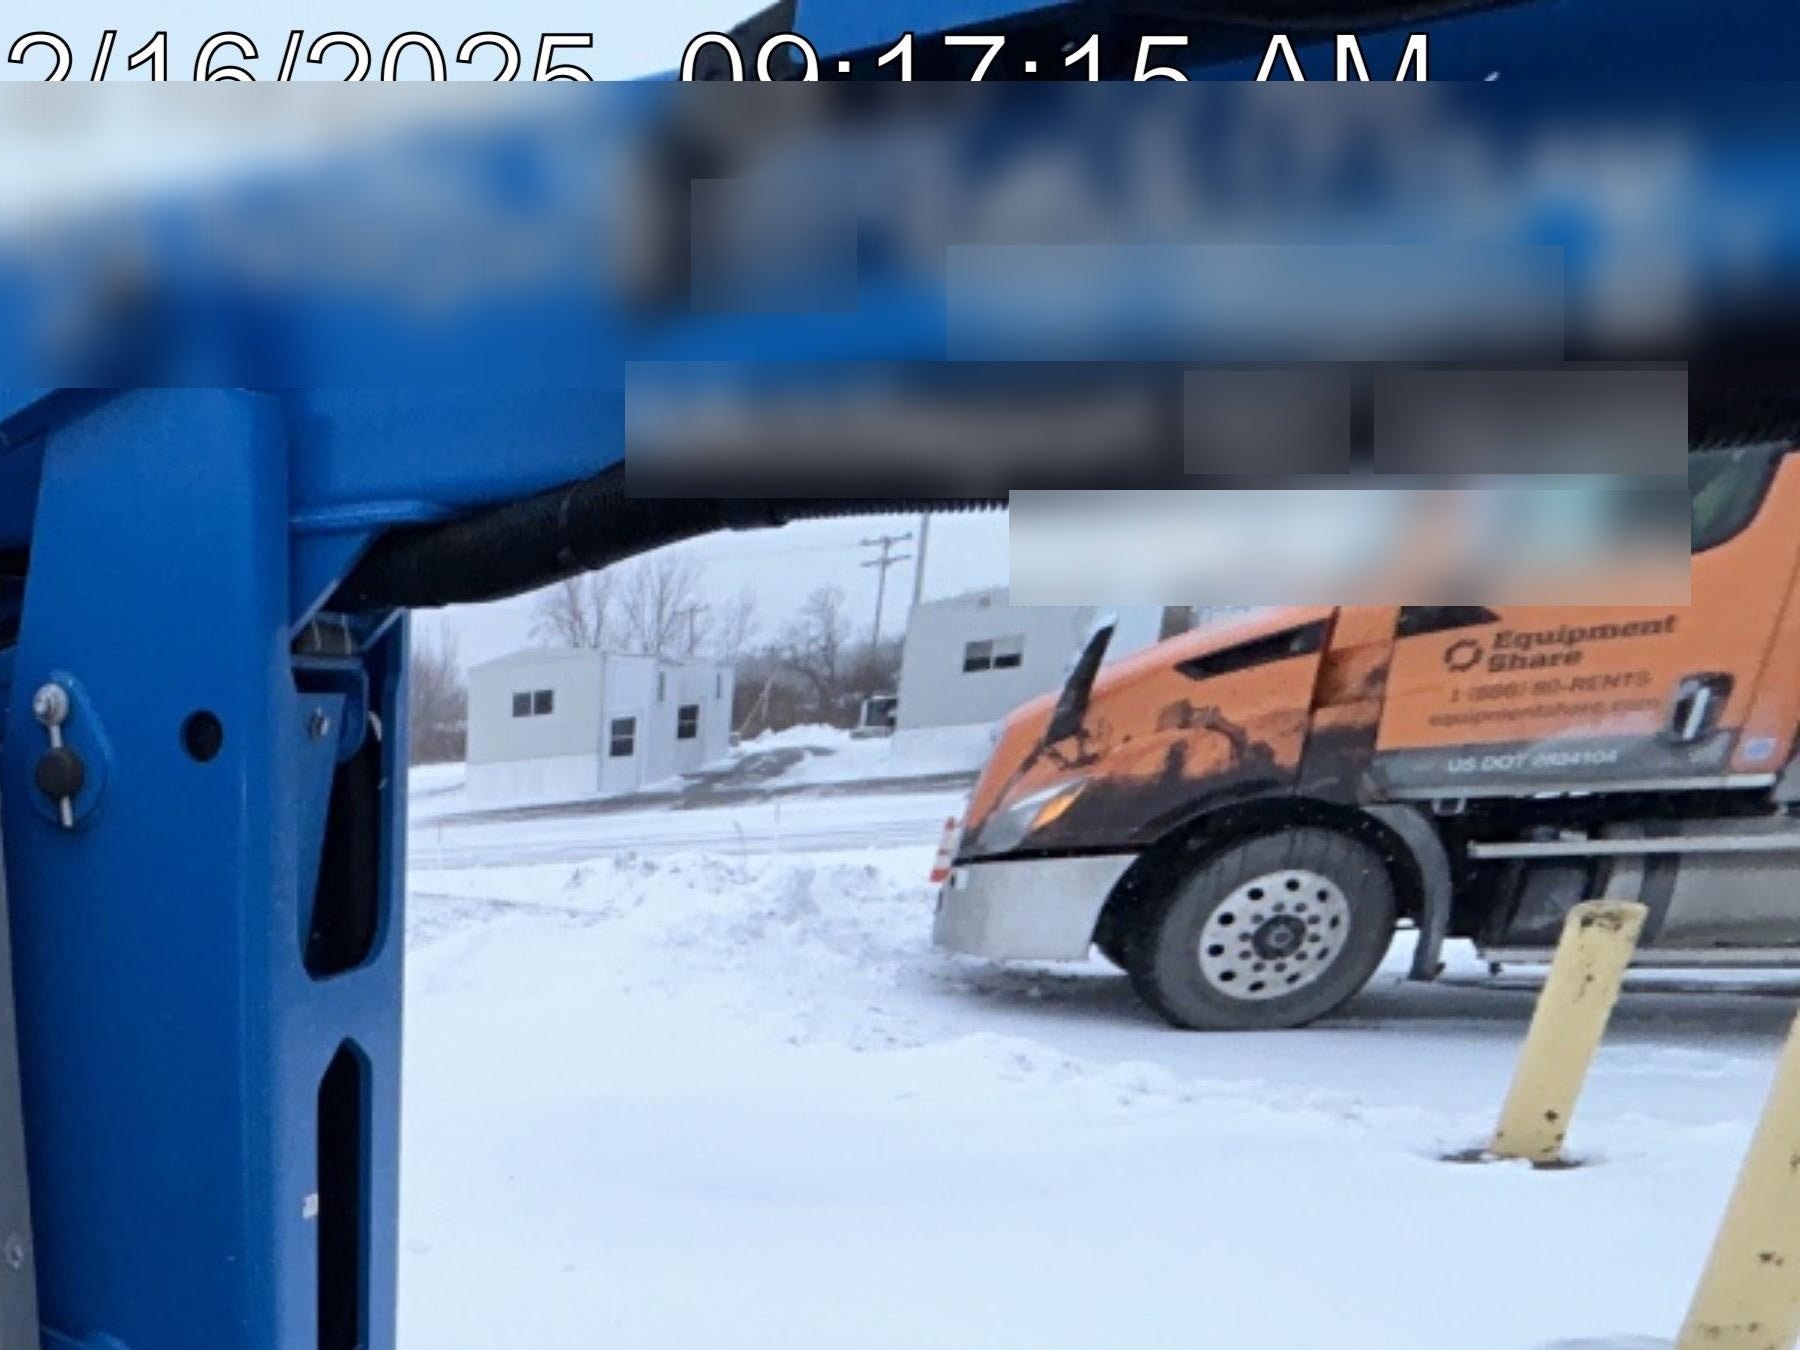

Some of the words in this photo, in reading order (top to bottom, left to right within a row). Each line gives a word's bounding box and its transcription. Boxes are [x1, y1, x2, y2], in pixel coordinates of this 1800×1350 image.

[1492, 613, 1679, 650] Equipment
[1487, 650, 1584, 673] Share
[1447, 755, 1477, 773] US
[1480, 752, 1530, 772] DOT
